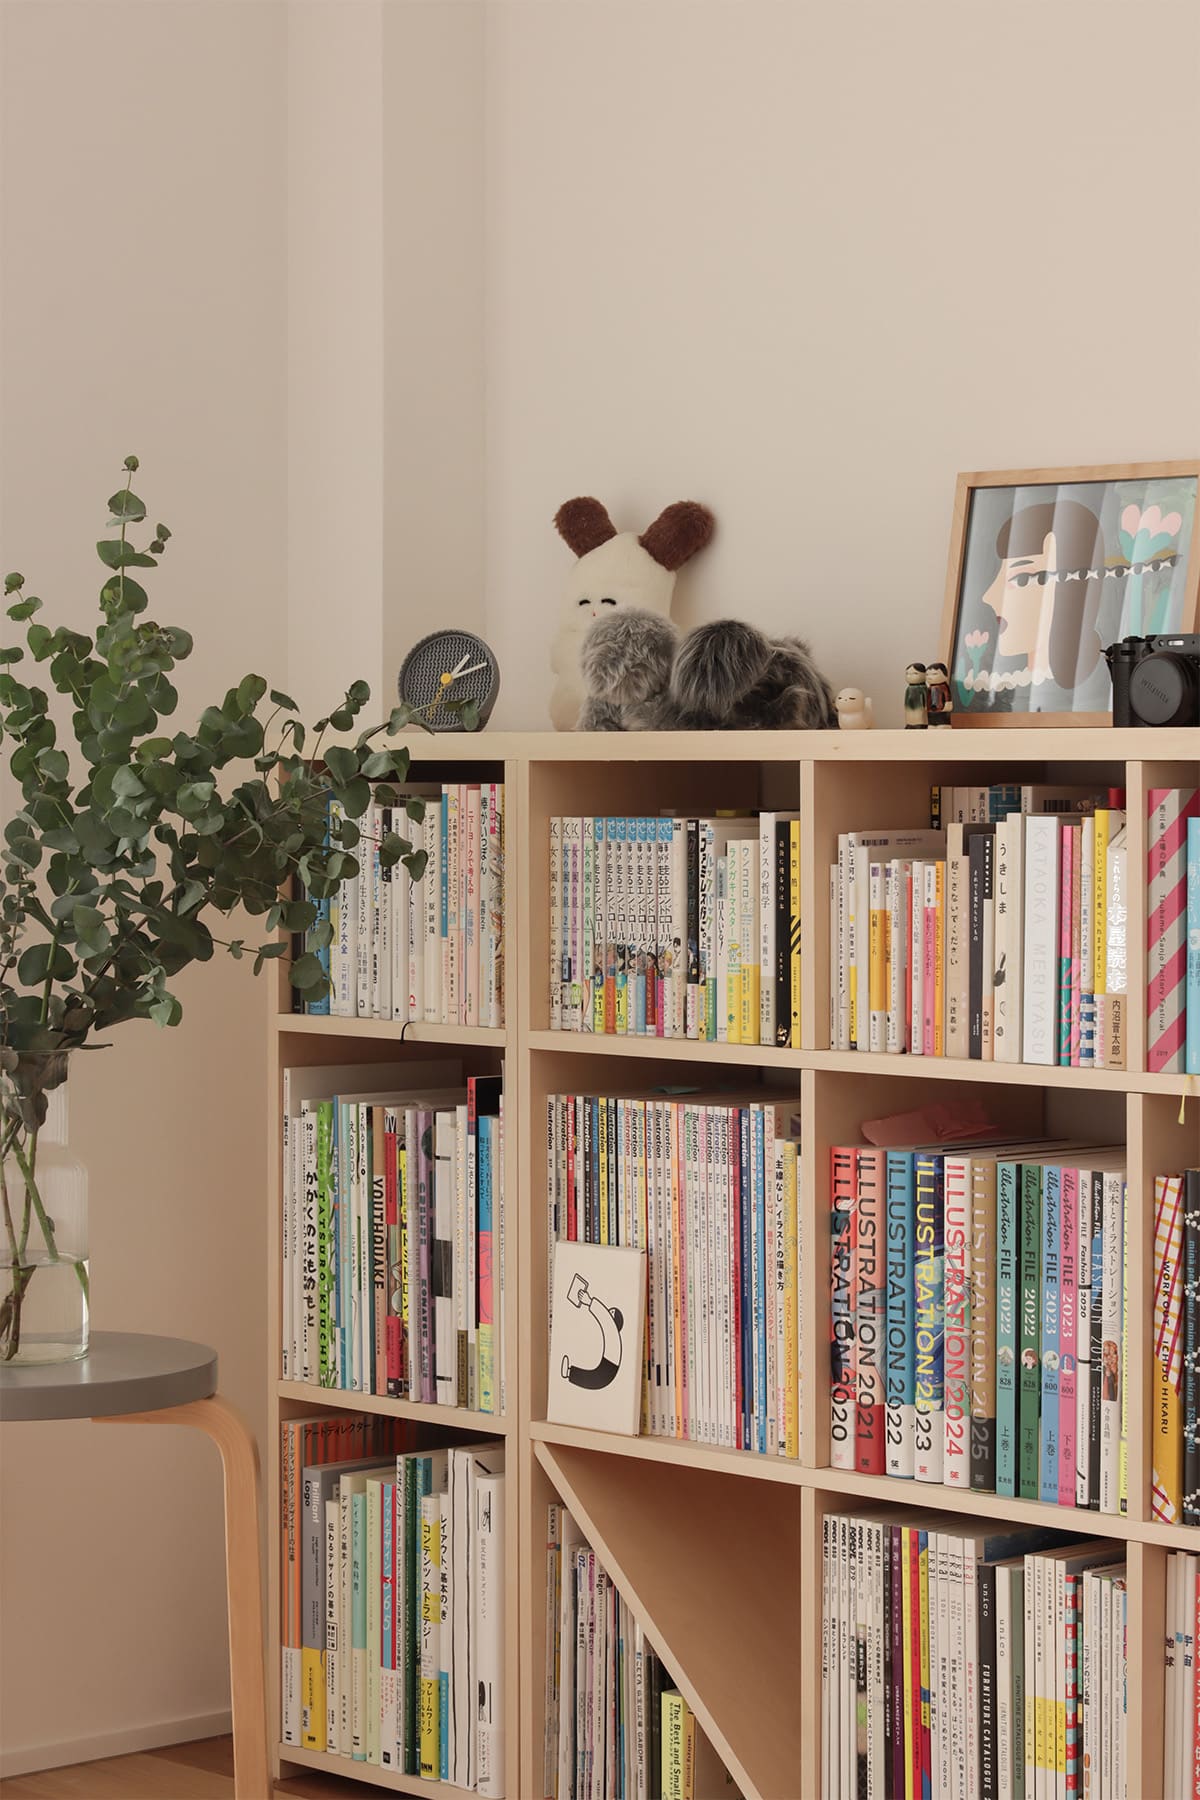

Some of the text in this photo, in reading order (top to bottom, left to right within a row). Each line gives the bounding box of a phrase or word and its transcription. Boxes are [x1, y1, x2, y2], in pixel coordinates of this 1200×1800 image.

[467, 810, 475, 897] ニューヨークで考え中
[728, 847, 737, 936] ラクガキ・マスター
[761, 833, 770, 909] センスの哲学
[1031, 826, 1049, 1055] KATAOKA MERIYASU
[1106, 855, 1128, 1056] これからの本屋読本 内沼晋太郎
[655, 1109, 663, 1158] illustration
[692, 1112, 700, 1162] illustration
[706, 1113, 714, 1164] illustration
[304, 1171, 318, 1328] かがくのとものもと
[319, 1191, 327, 1366] TATSURO KIUCHI
[373, 1178, 385, 1290] YOUTHQUAKE
[1000, 1168, 1012, 1334] illustration FILE 2022
[1024, 1169, 1037, 1336] illustration FILE 2022
[1045, 1170, 1058, 1335] illustration FILE 2023
[1062, 1173, 1075, 1338] illustration FILE 2023
[1080, 1244, 1089, 1284] Fashion
[1091, 1253, 1103, 1324] FASHION
[1108, 1179, 1120, 1319] 絵本とイラストレーション
[831, 1154, 851, 1441] ILLUSTRATION 2020
[857, 1157, 876, 1440] ILLUSTRATION 2021
[887, 1159, 907, 1445] ILLUSTRATION 2022
[915, 1161, 934, 1451] ILLUSTRATION 2023
[945, 1165, 965, 1457] ILLUSTRATION 2024
[971, 1167, 990, 1460] ILLUSTRATION 2025
[1160, 1260, 1171, 1434] WORK OUT ICHIJO HIKARU
[304, 1480, 312, 1508] Logo
[1000, 1426, 1010, 1451] 上巻
[1024, 1428, 1034, 1455] 下巻
[1046, 1430, 1056, 1457] 上巻
[1063, 1434, 1073, 1460] 下巻
[311, 1481, 320, 1523] Brilliant
[423, 1524, 431, 1649] コンテンツ ストラテジー
[596, 1573, 606, 1596] Begin
[673, 1703, 682, 1795] The Best and Small
[983, 1664, 992, 1790] FURNITURE CATALOGUE
